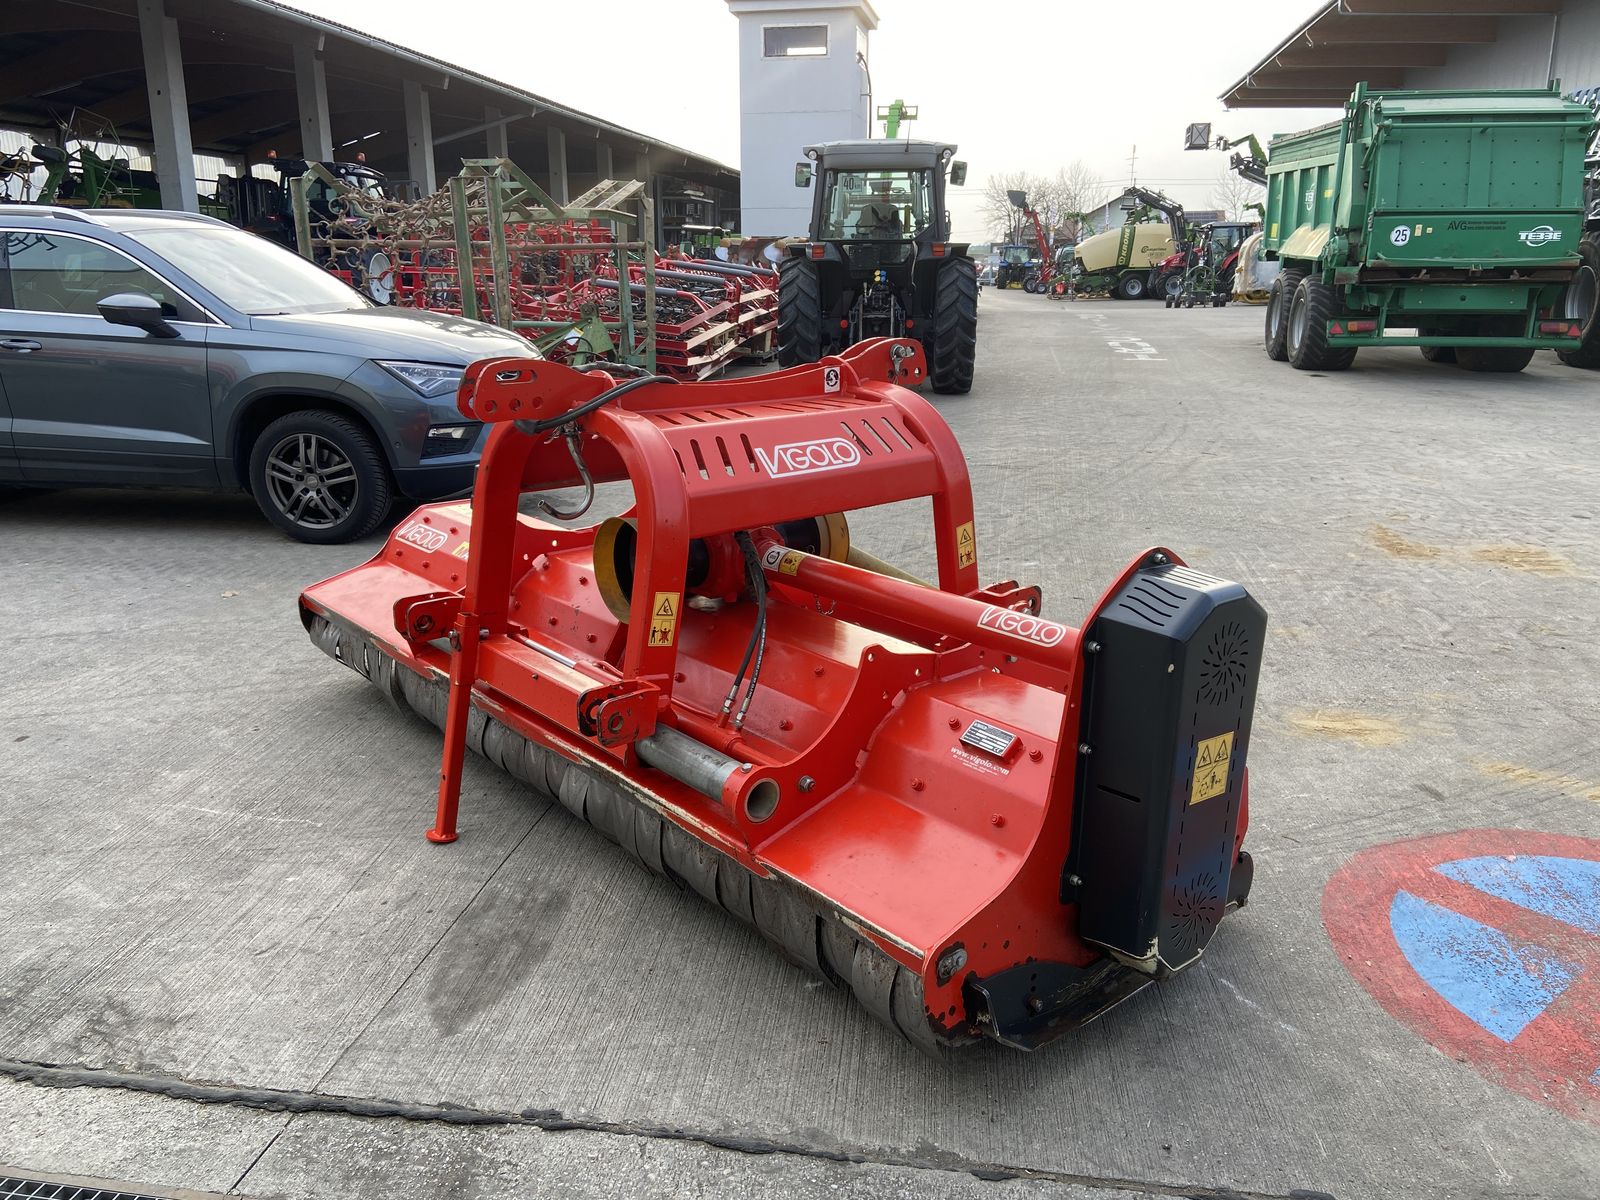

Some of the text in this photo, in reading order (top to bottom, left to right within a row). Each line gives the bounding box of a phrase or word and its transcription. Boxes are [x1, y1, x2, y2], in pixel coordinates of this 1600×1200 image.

[844, 177, 855, 190] 40
[1394, 229, 1408, 242] 25
[1448, 220, 1467, 230] AVG
[754, 440, 858, 475] VIGOLO
[397, 520, 446, 551] VIGOLO
[978, 606, 1063, 645] VIGOLO
